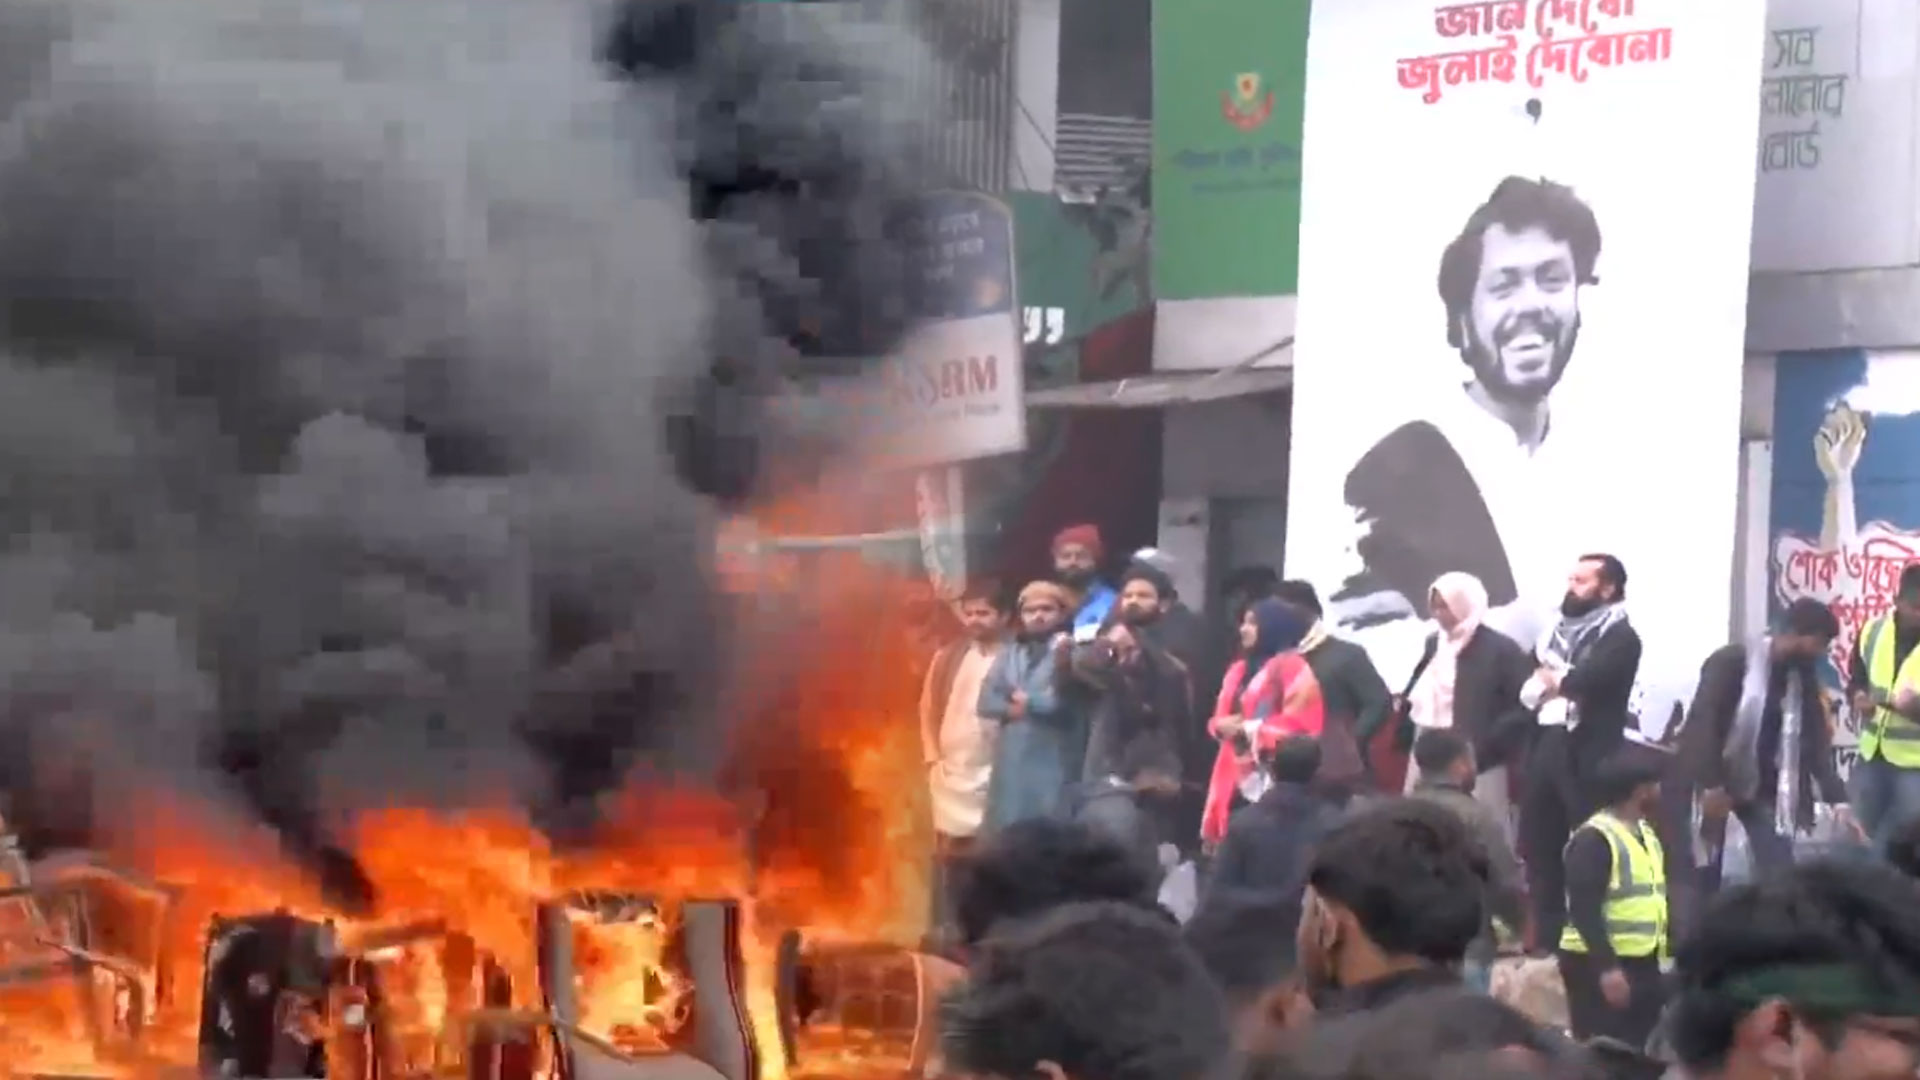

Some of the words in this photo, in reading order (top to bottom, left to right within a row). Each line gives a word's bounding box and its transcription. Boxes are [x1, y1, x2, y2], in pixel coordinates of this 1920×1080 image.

[1397, 35, 1519, 104] জুলাই
[1525, 28, 1672, 88] দেবোনা
[1771, 25, 1822, 69] সব
[1761, 120, 1821, 173] বোর্ড
[1786, 548, 1840, 592] শোক
